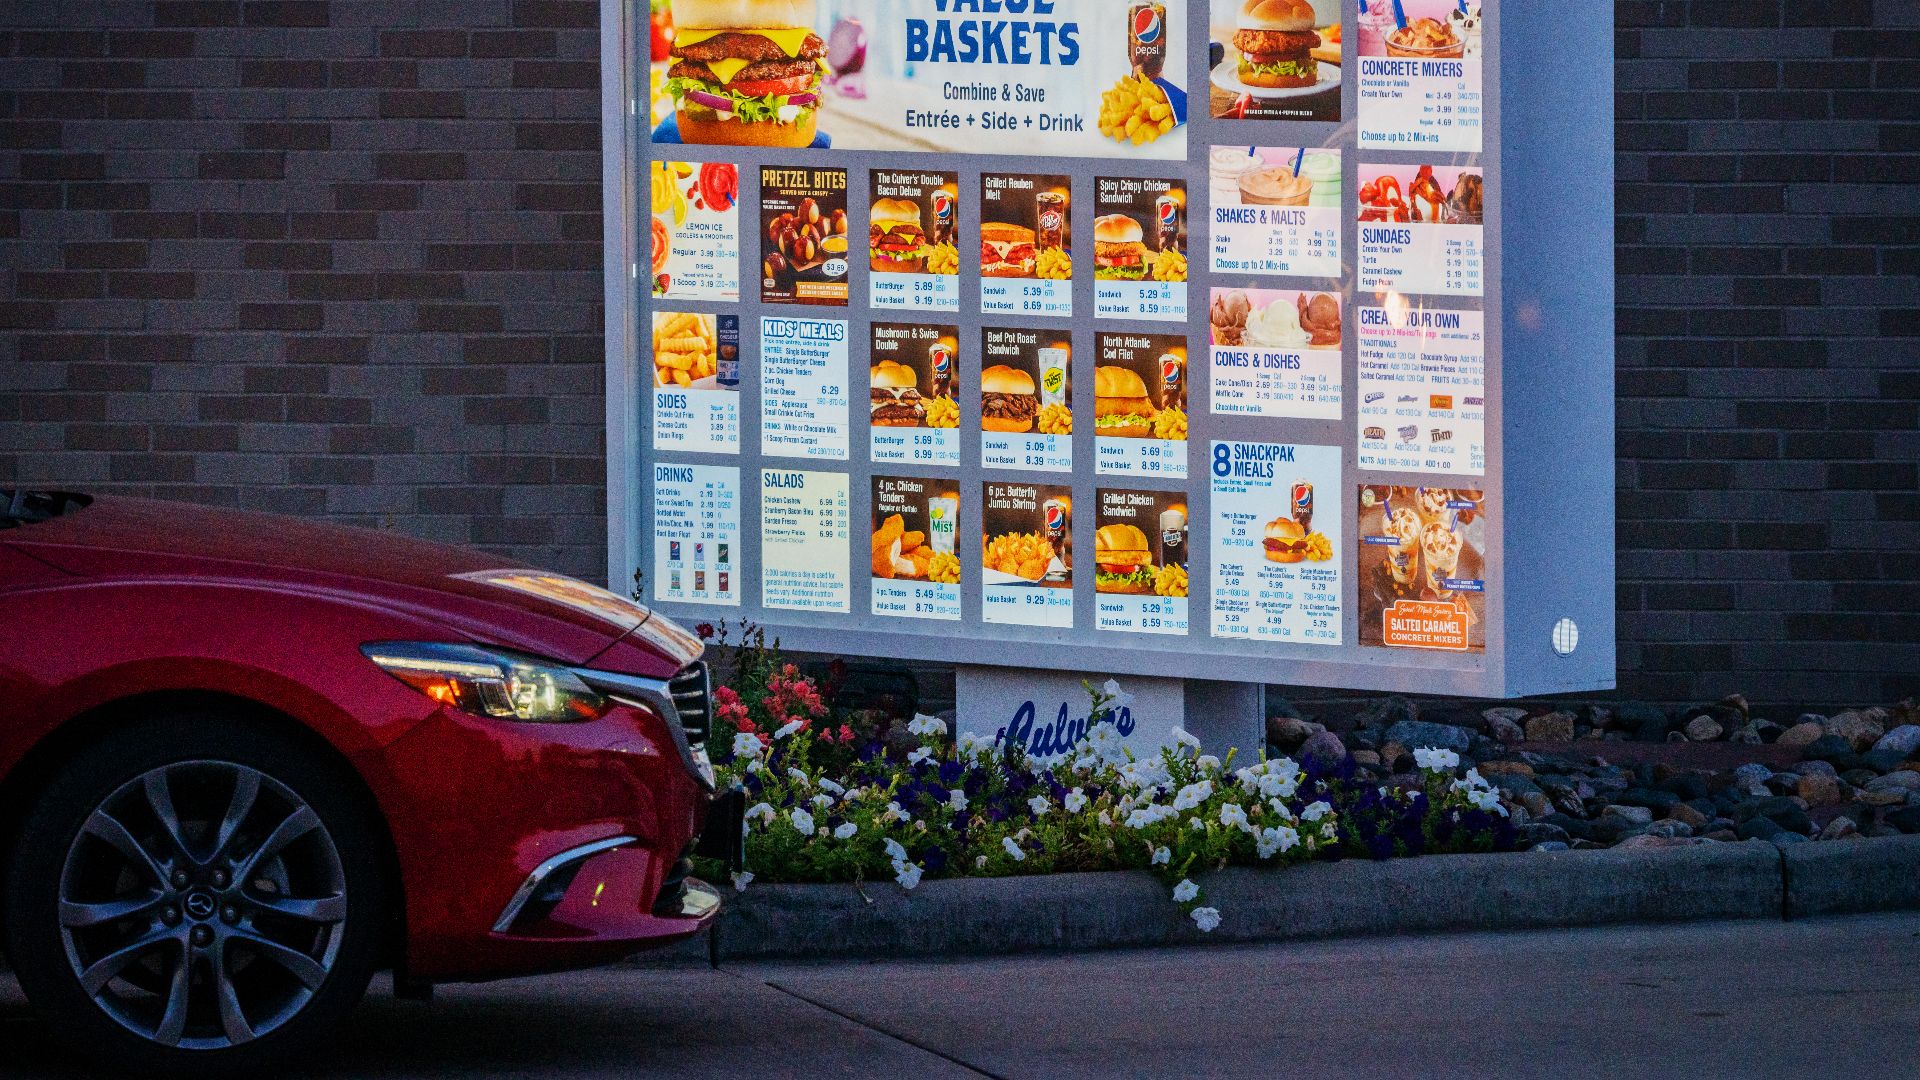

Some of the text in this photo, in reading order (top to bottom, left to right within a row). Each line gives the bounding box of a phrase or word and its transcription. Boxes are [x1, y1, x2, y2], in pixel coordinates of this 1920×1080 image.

[905, 19, 1080, 66] BASKETS
[1135, 45, 1159, 56] pepsi
[1362, 60, 1463, 77] CONCRETE MIXERS
[943, 82, 1045, 102] Combine & Save
[906, 109, 1084, 132] Entrée + Side + Drink
[1361, 130, 1439, 143] Choose up to 2 Mix-ins
[762, 169, 846, 190] PRETZEL BITES
[877, 173, 944, 185] The Culver's Double
[985, 177, 1033, 189] Grilled Reuben
[877, 185, 922, 197] Bacon Deluxe
[1100, 180, 1170, 193] Spicy Crispy Chicken
[985, 189, 1001, 200] Melt
[1100, 192, 1133, 204] Sandwich
[1216, 208, 1306, 226] SHAKES & MALTS
[685, 222, 723, 231] LEMON ICE
[1362, 228, 1411, 245] SUNDAES
[1307, 239, 1322, 247] 3.99
[672, 248, 697, 257] Regular
[1216, 258, 1289, 271] Choose up to 2 Mix-ins
[678, 279, 697, 288] Scoop
[701, 280, 714, 288] 3.19
[914, 281, 933, 291] 5.89
[1023, 286, 1042, 296] 5.39
[1140, 289, 1158, 299] 5.29
[914, 295, 933, 305] 9.19
[1023, 300, 1042, 310] 8.69
[1140, 304, 1158, 313] 8.59
[1361, 309, 1403, 327] CREA
[1434, 313, 1460, 329] OWN
[763, 319, 844, 341] KIDS' MEALS
[875, 328, 939, 339] Mushroom & Swiss
[987, 331, 1037, 344] Beef Pot Roast
[1103, 336, 1150, 349] North Atlantic
[1470, 333, 1481, 341] .25
[875, 339, 898, 350] Double
[987, 343, 1020, 355] Sandwich
[1103, 348, 1134, 360] Cod Filet
[1369, 351, 1384, 359] Fudge
[1215, 351, 1300, 369] CONES & DISHES
[821, 386, 839, 395] 6.29
[657, 394, 687, 409] SIDES
[1300, 394, 1315, 402] 4.19
[874, 435, 932, 445] ButterBurger 5.69
[985, 441, 1044, 451] Sandwich 5.09
[1141, 446, 1160, 456] 5.69
[914, 449, 932, 459] 8.99
[1026, 455, 1044, 466] 8.39
[1213, 443, 1295, 477] 8 SNACKPAK
[1437, 461, 1451, 469] 1.00
[1141, 461, 1160, 471] 8.99
[1234, 461, 1274, 479] MEALS
[656, 467, 693, 483] DRINKS
[764, 473, 804, 489] SALADS
[878, 479, 923, 493] 4 pc. Chicken
[879, 492, 905, 503] Tenders
[988, 485, 1037, 500] 6 pc. Butterfly
[1103, 493, 1154, 505] Grilled Chicken
[878, 504, 895, 513] Regular
[988, 498, 1036, 512] Jumbo Shrimp
[1103, 506, 1136, 517] Sandwich
[819, 519, 833, 527] 4.99
[932, 520, 953, 533] Mist
[819, 530, 833, 538] 6.99
[1231, 528, 1246, 536] 5.29
[1269, 581, 1283, 589] 5.99
[1311, 583, 1326, 591] 5.79
[915, 589, 934, 599] 5.49
[1026, 595, 1045, 605] 9.29
[915, 603, 934, 613] 8.79
[1142, 603, 1160, 613] 5.29
[1142, 619, 1160, 627] 8.59
[1267, 617, 1282, 625] 4.99
[1313, 620, 1327, 628] 5.79
[1391, 617, 1461, 634] SALTED CARAMEL
[1391, 632, 1463, 644] CONCRETE MIXERS
